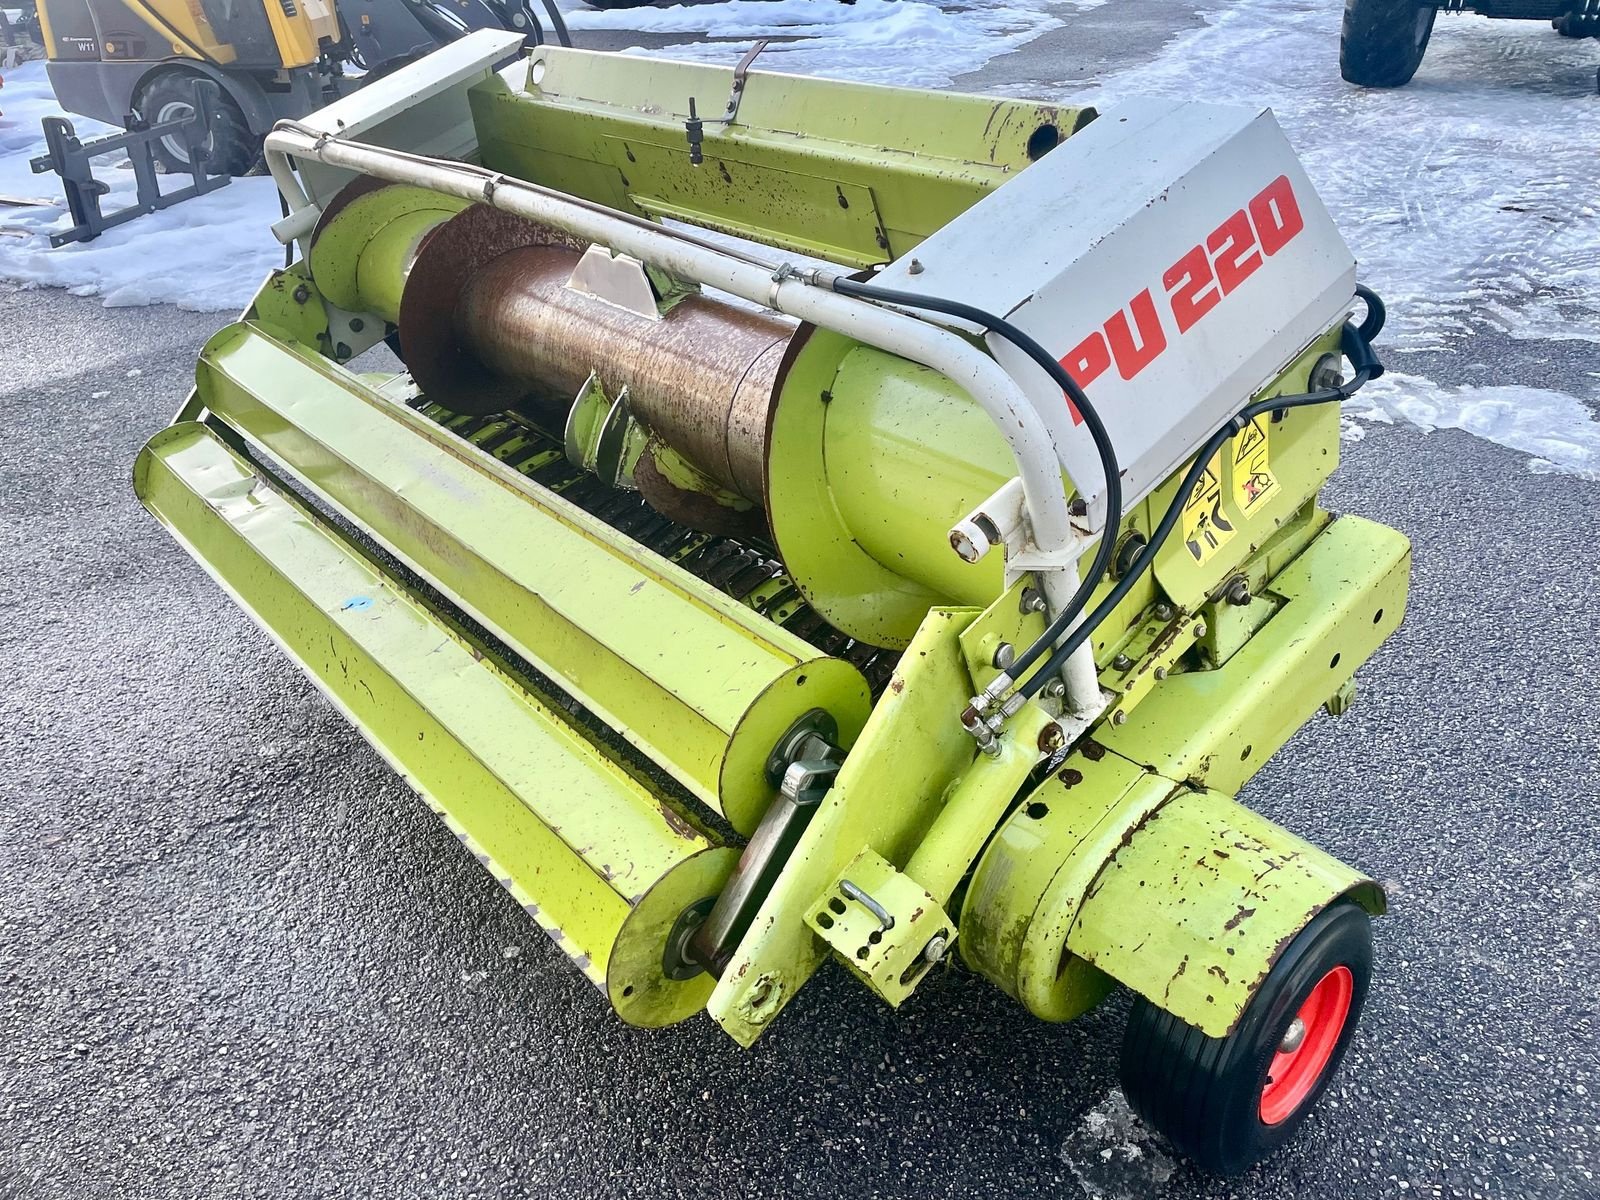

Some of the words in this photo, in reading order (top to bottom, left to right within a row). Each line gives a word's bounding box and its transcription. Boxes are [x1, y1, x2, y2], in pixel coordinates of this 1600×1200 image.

[78, 42, 95, 51] W11
[1057, 287, 1167, 427] PU
[1163, 174, 1304, 335] 220
